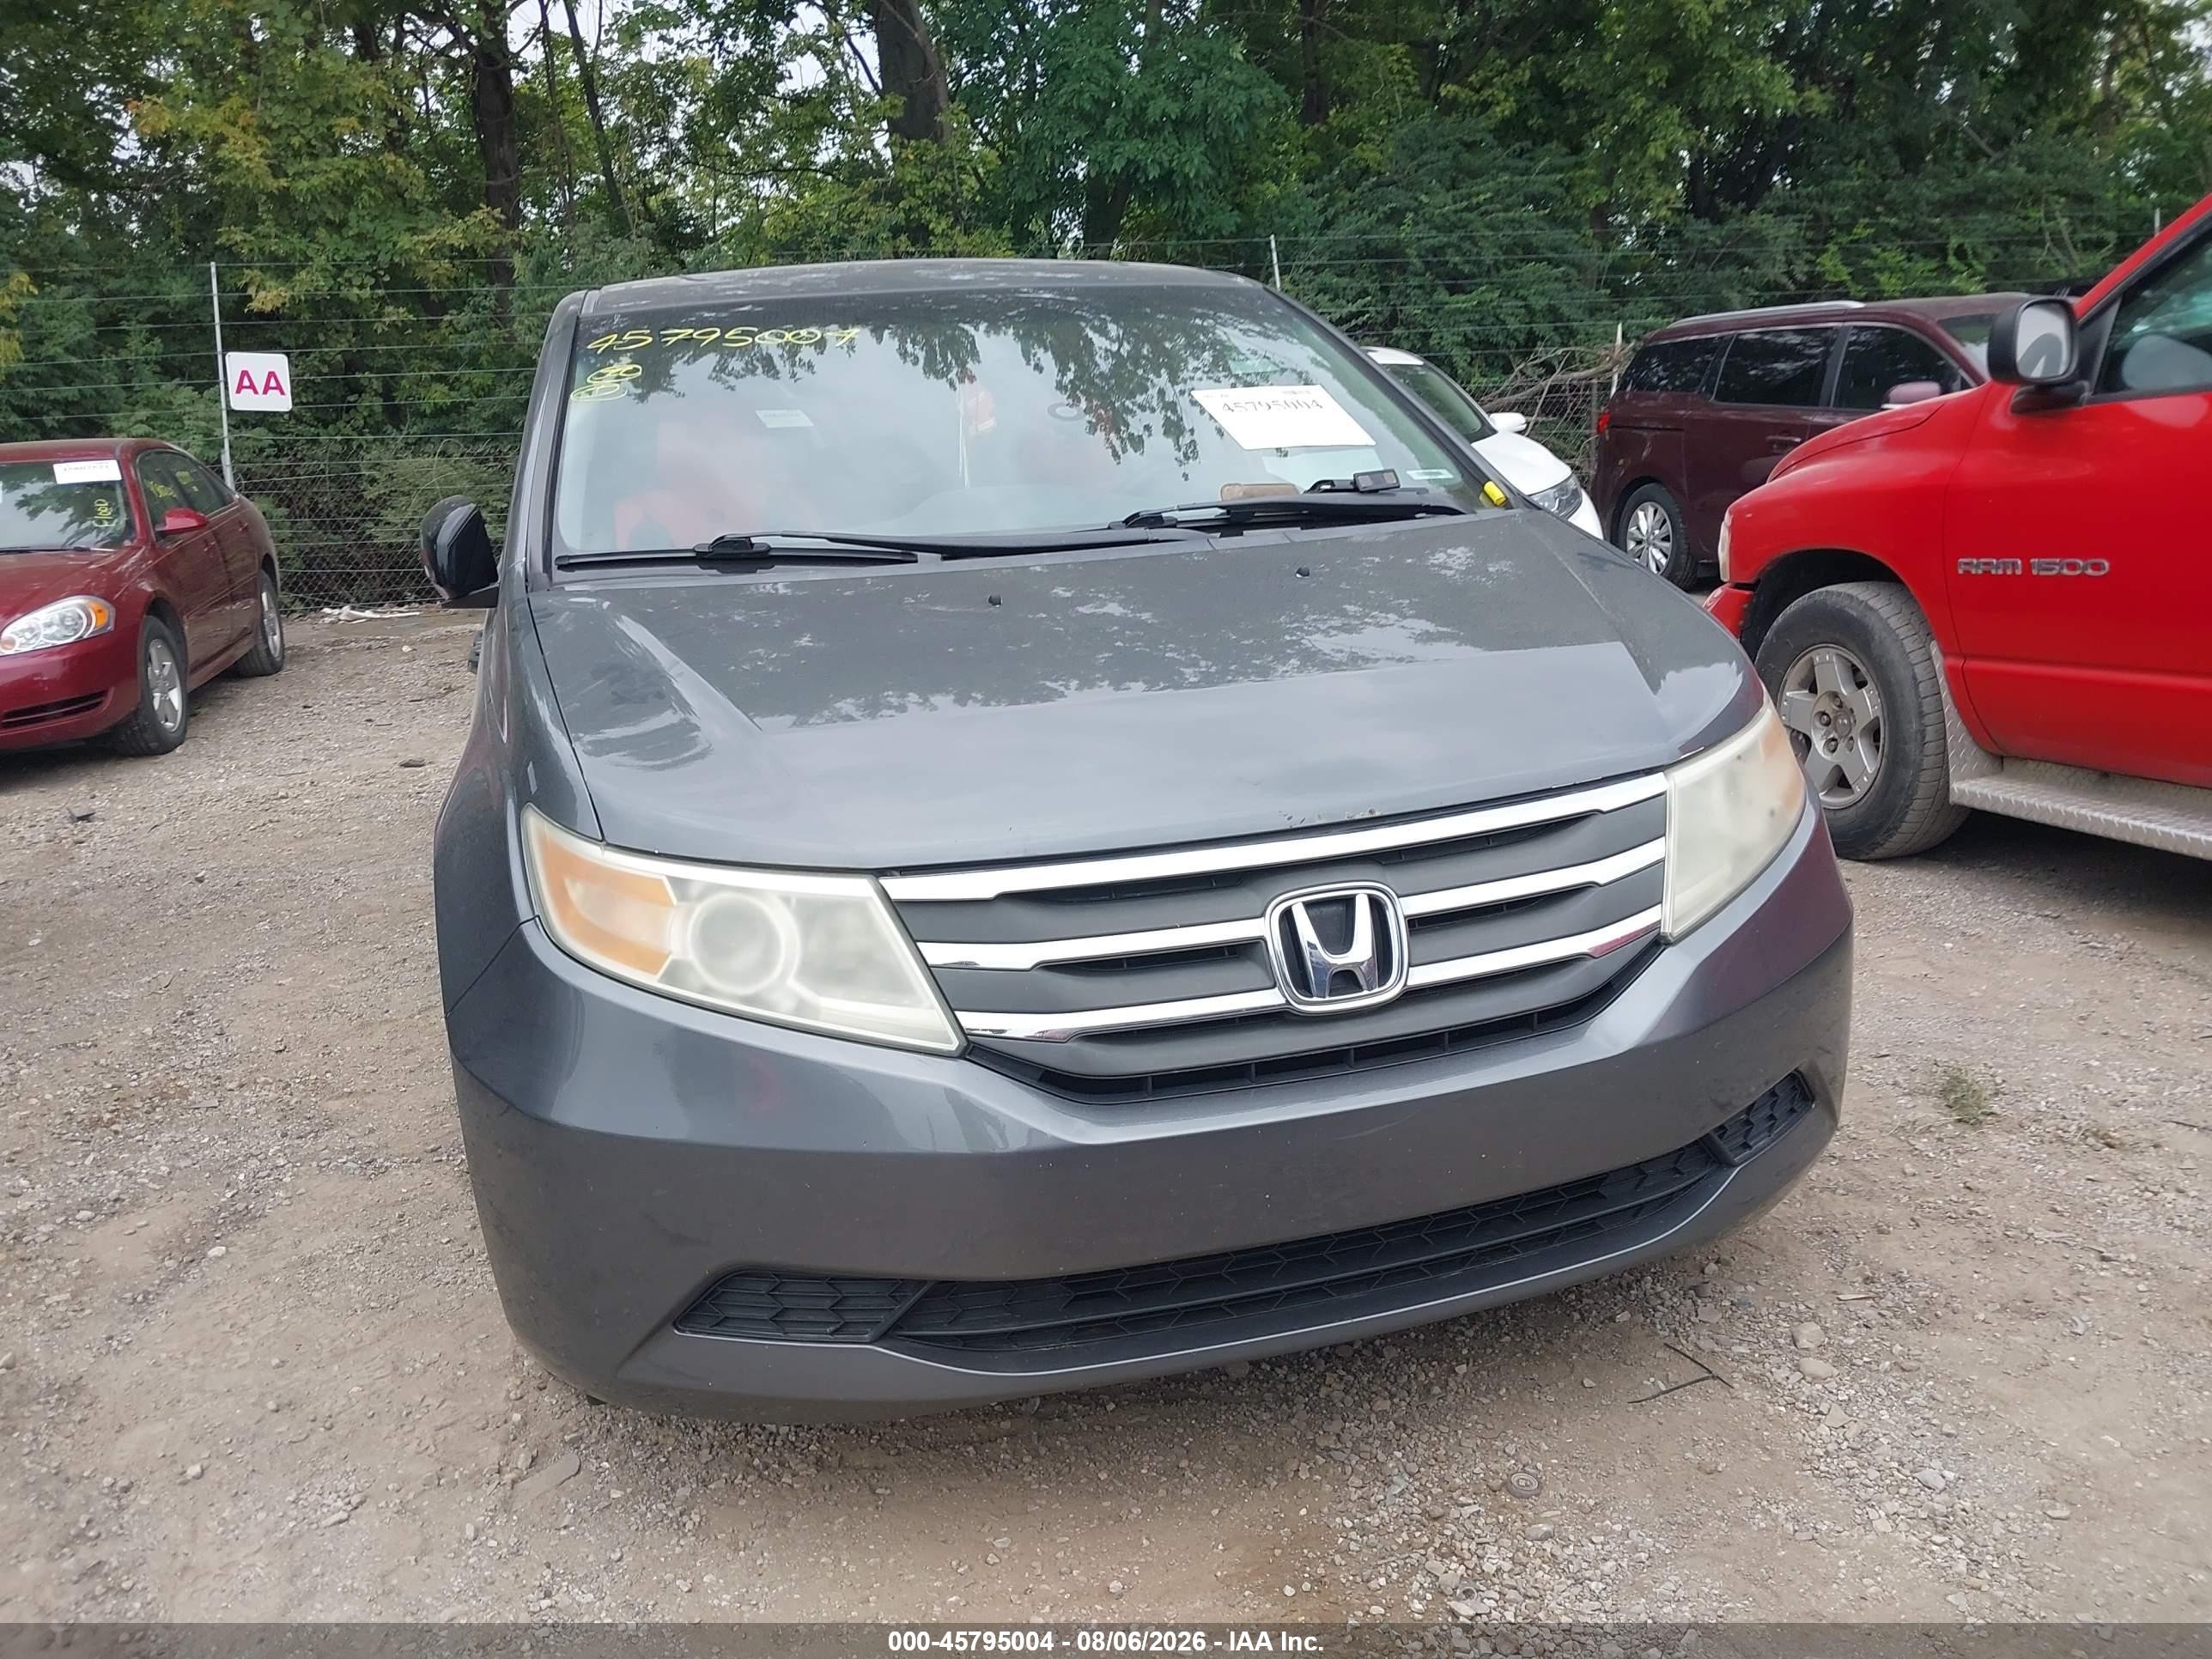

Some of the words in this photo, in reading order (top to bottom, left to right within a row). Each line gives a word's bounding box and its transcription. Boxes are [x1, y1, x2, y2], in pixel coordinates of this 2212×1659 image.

[235, 369, 286, 396] AA
[1957, 557, 2022, 576] RAM
[2030, 557, 2110, 577] 1500
